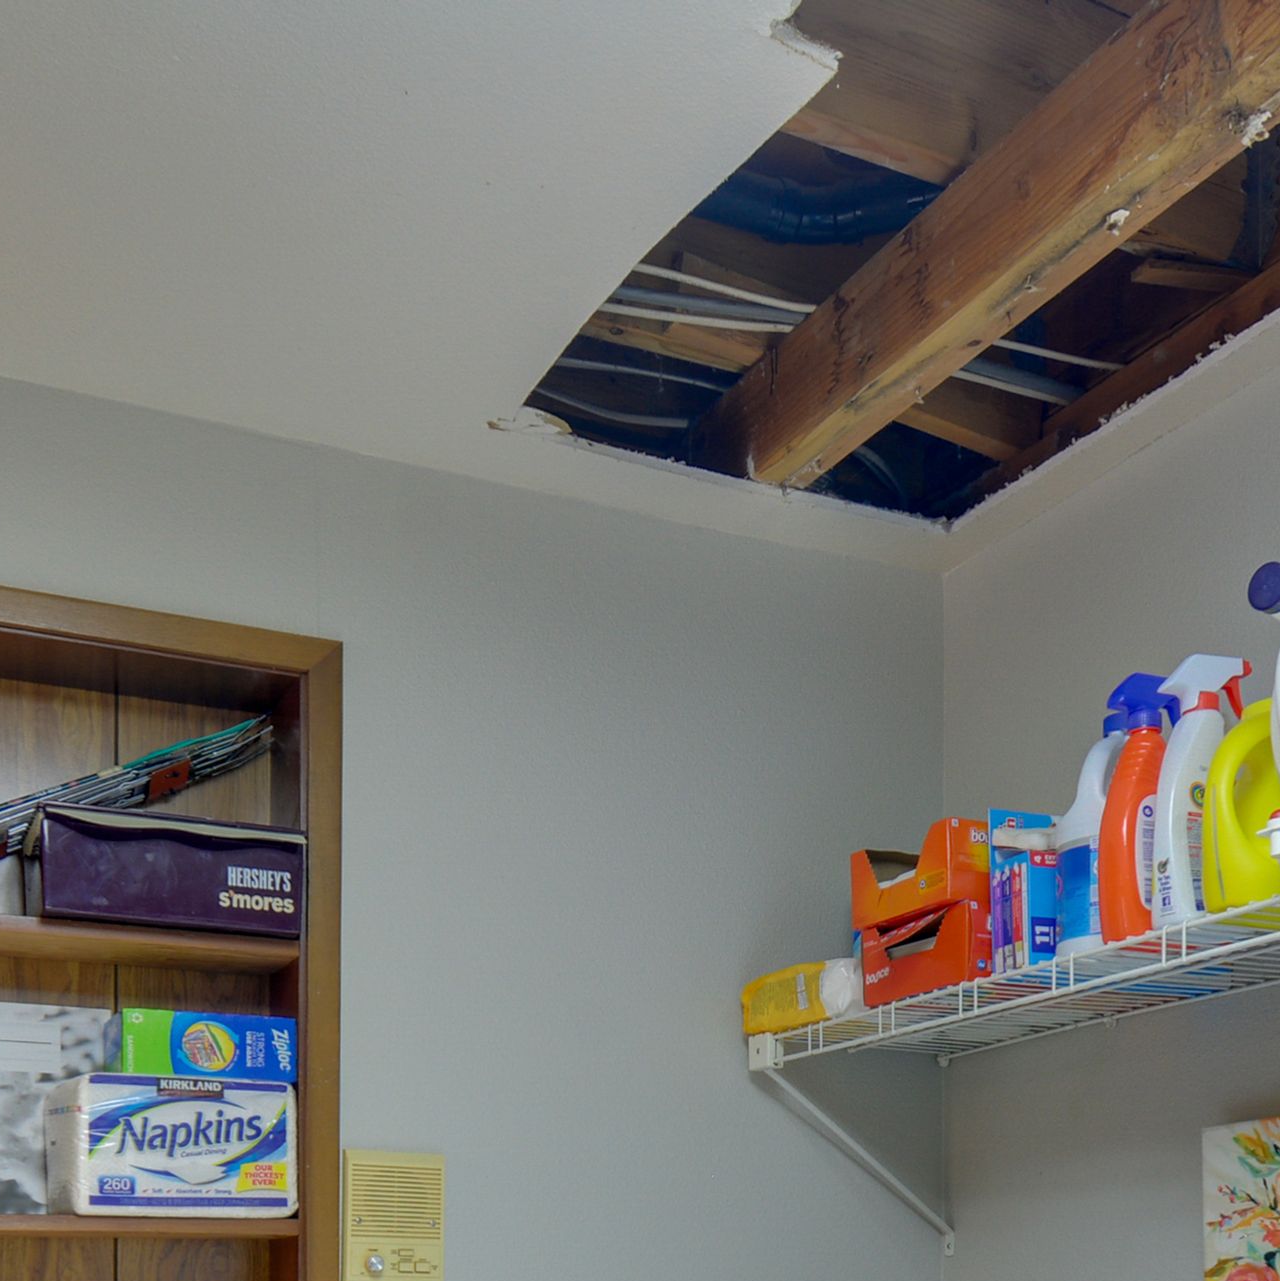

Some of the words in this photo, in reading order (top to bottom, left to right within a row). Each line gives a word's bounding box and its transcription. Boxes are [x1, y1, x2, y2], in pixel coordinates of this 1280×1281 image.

[227, 866, 291, 892] HERSHEY'S
[219, 889, 294, 913] s'mores
[866, 967, 890, 984] bounce
[256, 1032, 265, 1067] STRONG
[271, 1028, 292, 1072] Ziploc
[160, 1079, 222, 1092] KIRKLAND
[116, 1110, 263, 1157] Napkins
[180, 1149, 203, 1158] Casual
[204, 1147, 227, 1157] Dining
[103, 1178, 130, 1190] 260
[245, 1171, 284, 1180] THICKEST
[252, 1178, 276, 1186] EVER!
